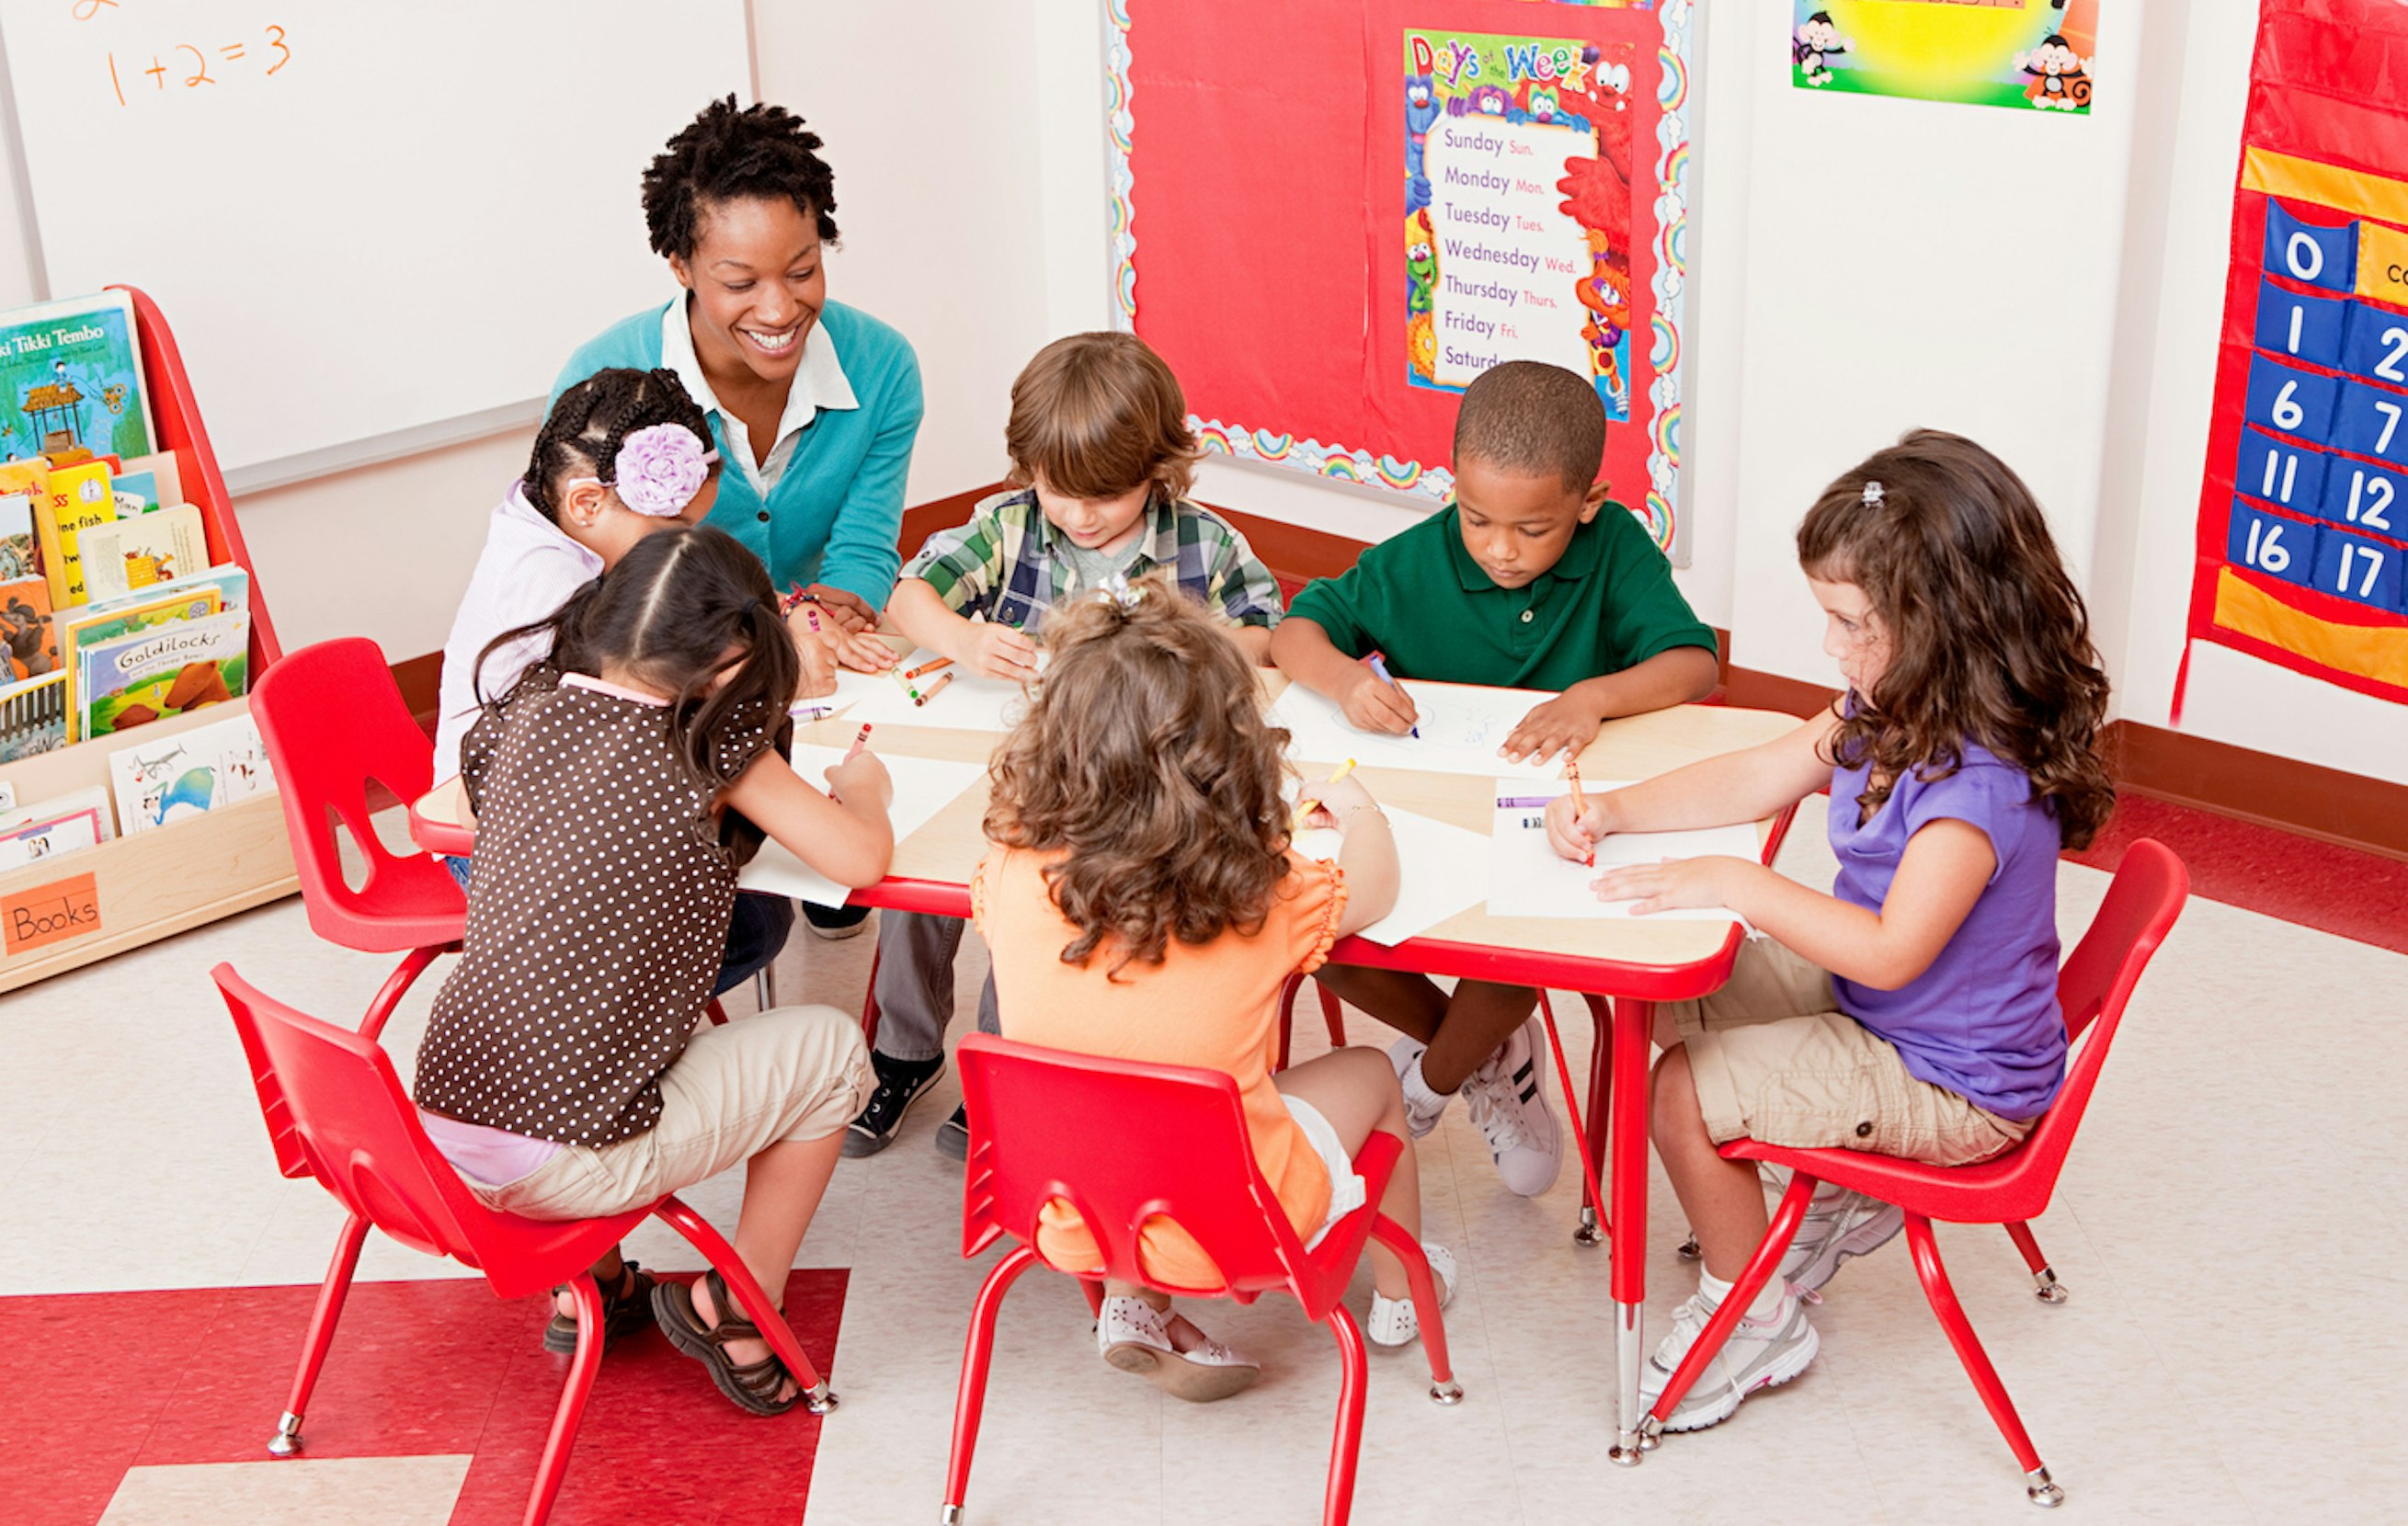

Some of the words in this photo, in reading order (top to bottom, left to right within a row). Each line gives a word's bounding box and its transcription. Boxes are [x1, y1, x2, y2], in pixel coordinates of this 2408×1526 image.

[1409, 35, 1480, 87] Days
[1505, 44, 1590, 93] Week
[1445, 129, 1503, 158] Sunday
[1510, 140, 1534, 155] Sun.
[1445, 166, 1510, 193] Monday
[1516, 179, 1545, 195] Mon.
[1445, 202, 1510, 231] Tuesday
[1516, 215, 1545, 232] Tues.
[1445, 239, 1539, 270] Wednesday
[1545, 256, 1577, 274] Wed.
[2288, 232, 2323, 280] 0
[1445, 275, 1517, 306] Thursday
[1524, 290, 1558, 309] Thurs.
[12, 334, 52, 353] Tikki
[52, 325, 105, 346] Tembo
[1445, 311, 1495, 339] Friday
[1501, 323, 1519, 338] Fri.
[1445, 346, 1505, 369] Saturd
[2288, 305, 2303, 354] 1
[2374, 327, 2408, 382] 2
[2272, 380, 2303, 429] 6
[2375, 401, 2402, 454] 7
[2262, 450, 2298, 503] 11
[2345, 470, 2394, 530] 12
[79, 513, 102, 529] fish
[2245, 518, 2290, 572] 16
[2337, 542, 2384, 598] 17
[120, 632, 220, 668] Goldilocks
[14, 896, 97, 940] Books
